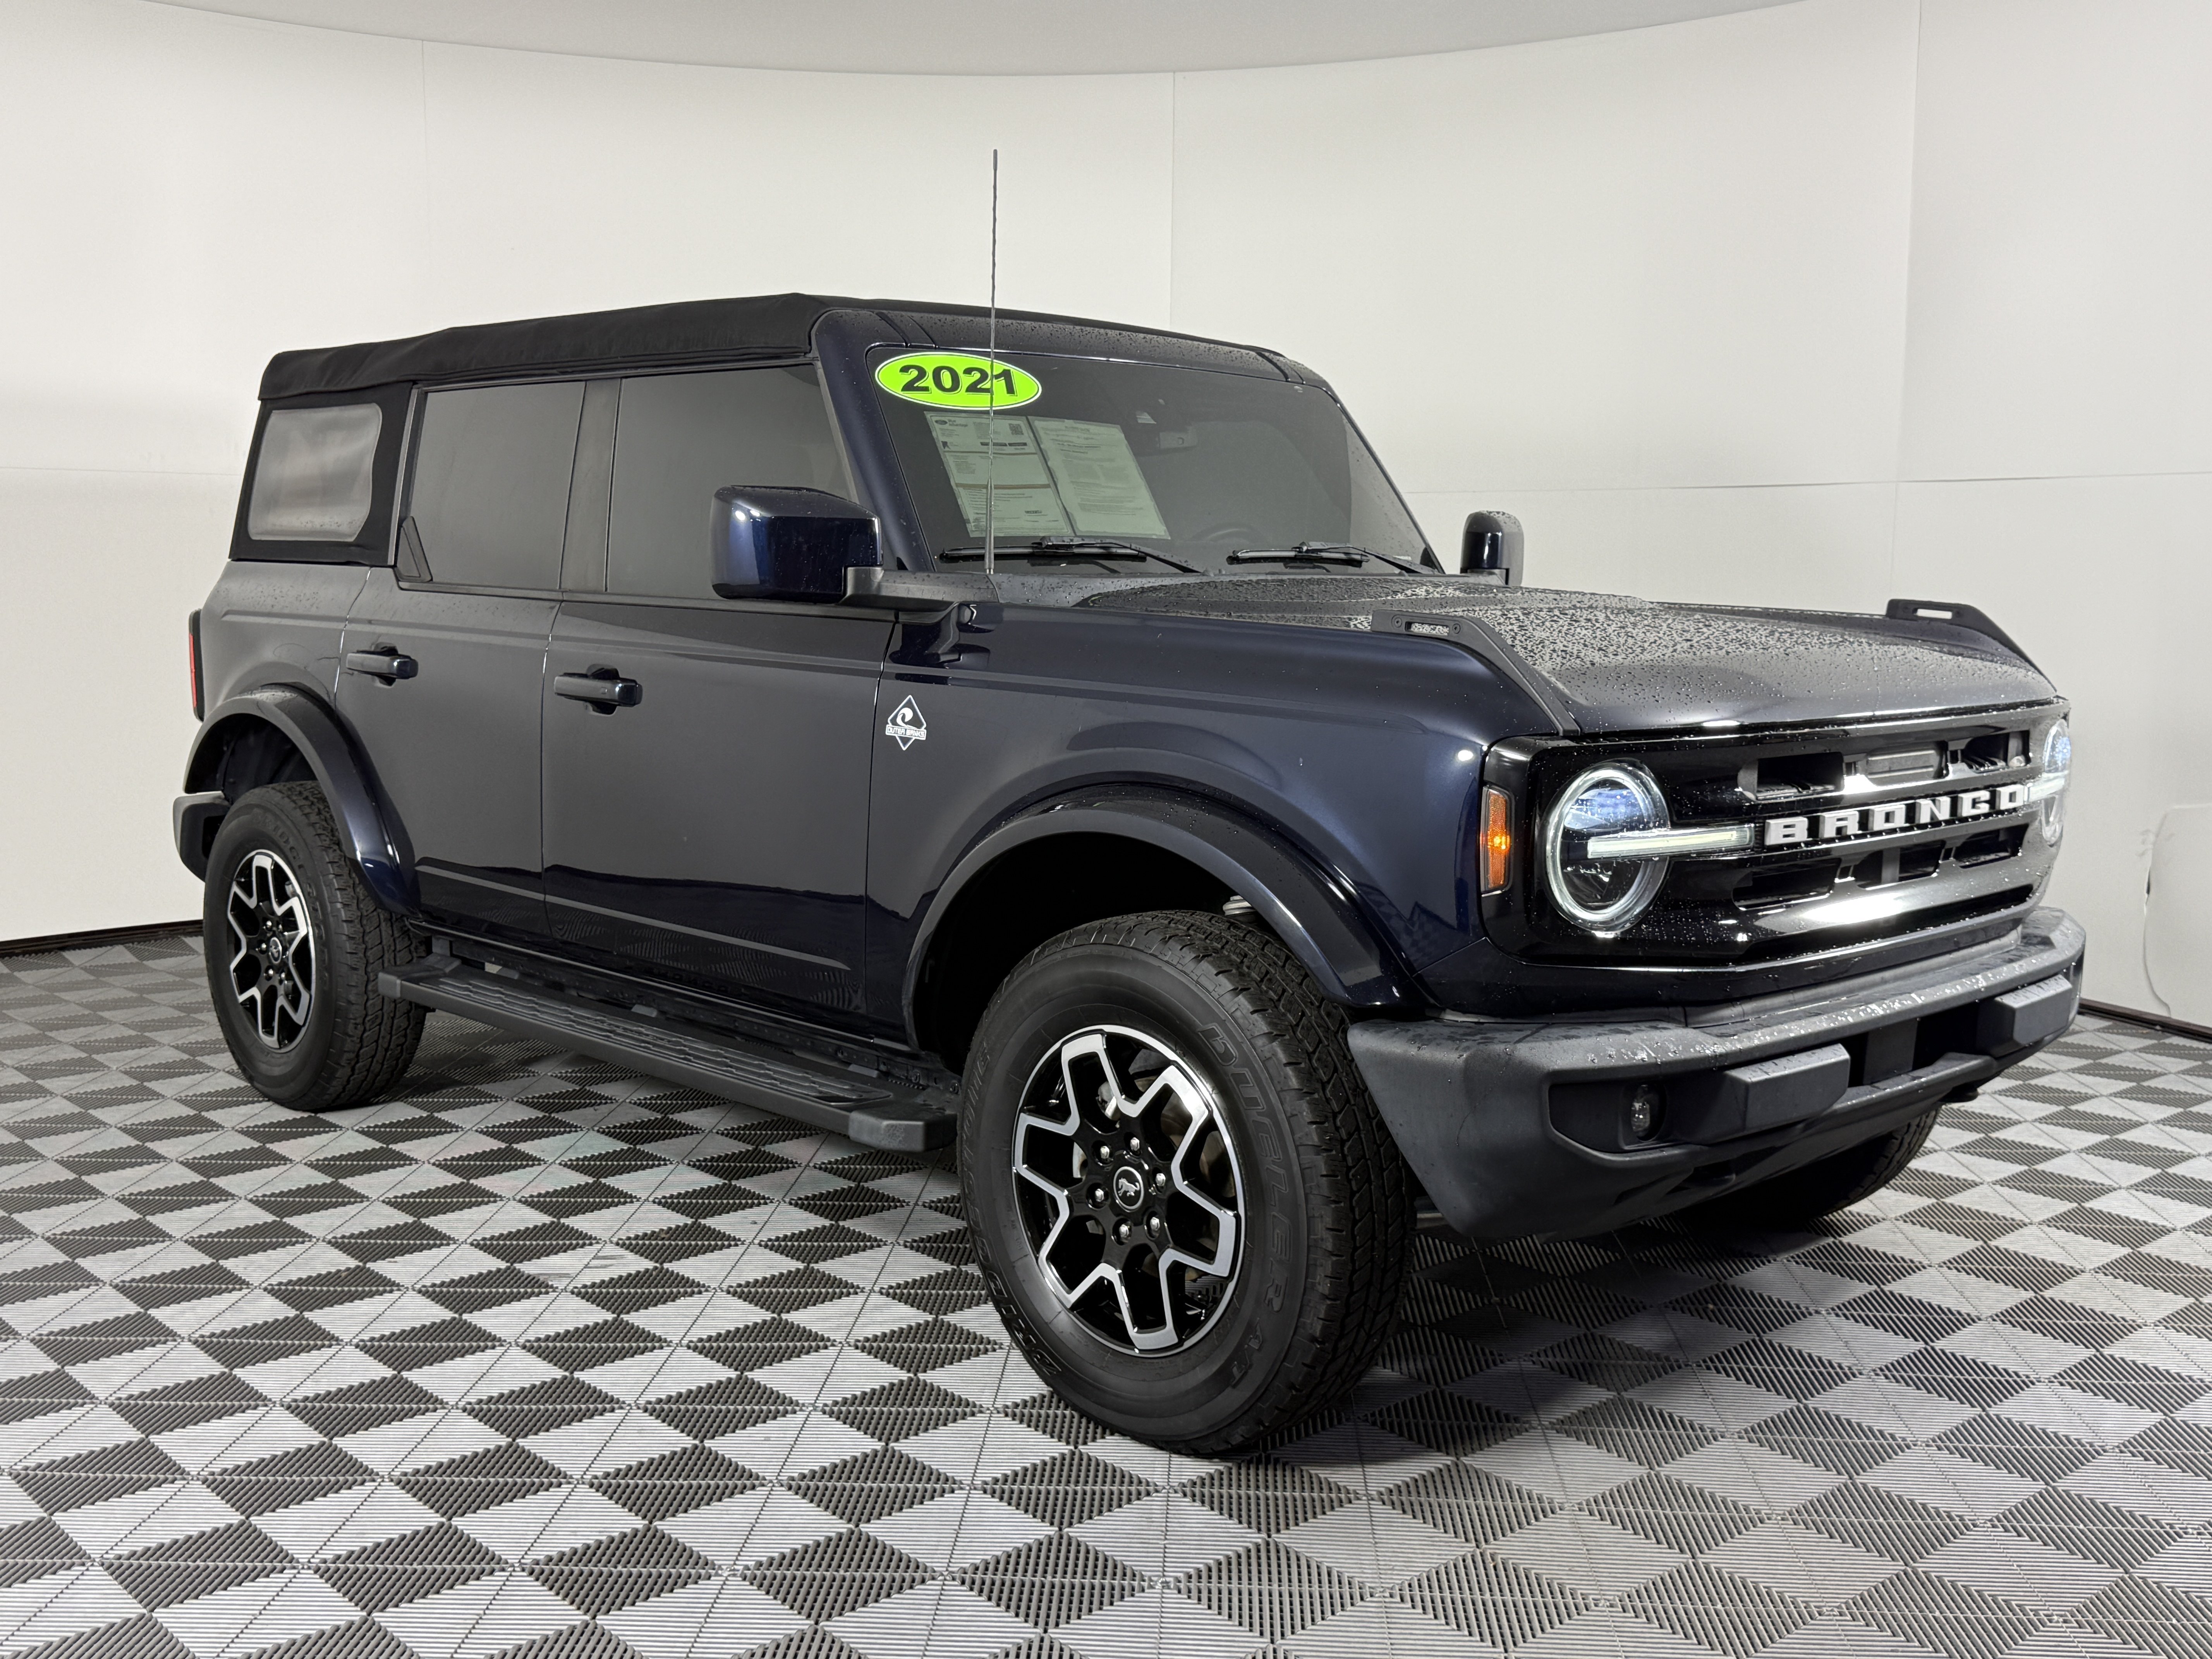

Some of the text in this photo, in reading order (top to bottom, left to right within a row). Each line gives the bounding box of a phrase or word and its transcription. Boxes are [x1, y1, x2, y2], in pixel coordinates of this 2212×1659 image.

[899, 364, 1018, 397] 2021
[888, 726, 905, 735] OUTER
[1764, 784, 2025, 846] BRONCO
[1197, 1024, 1292, 1314] DUELER
